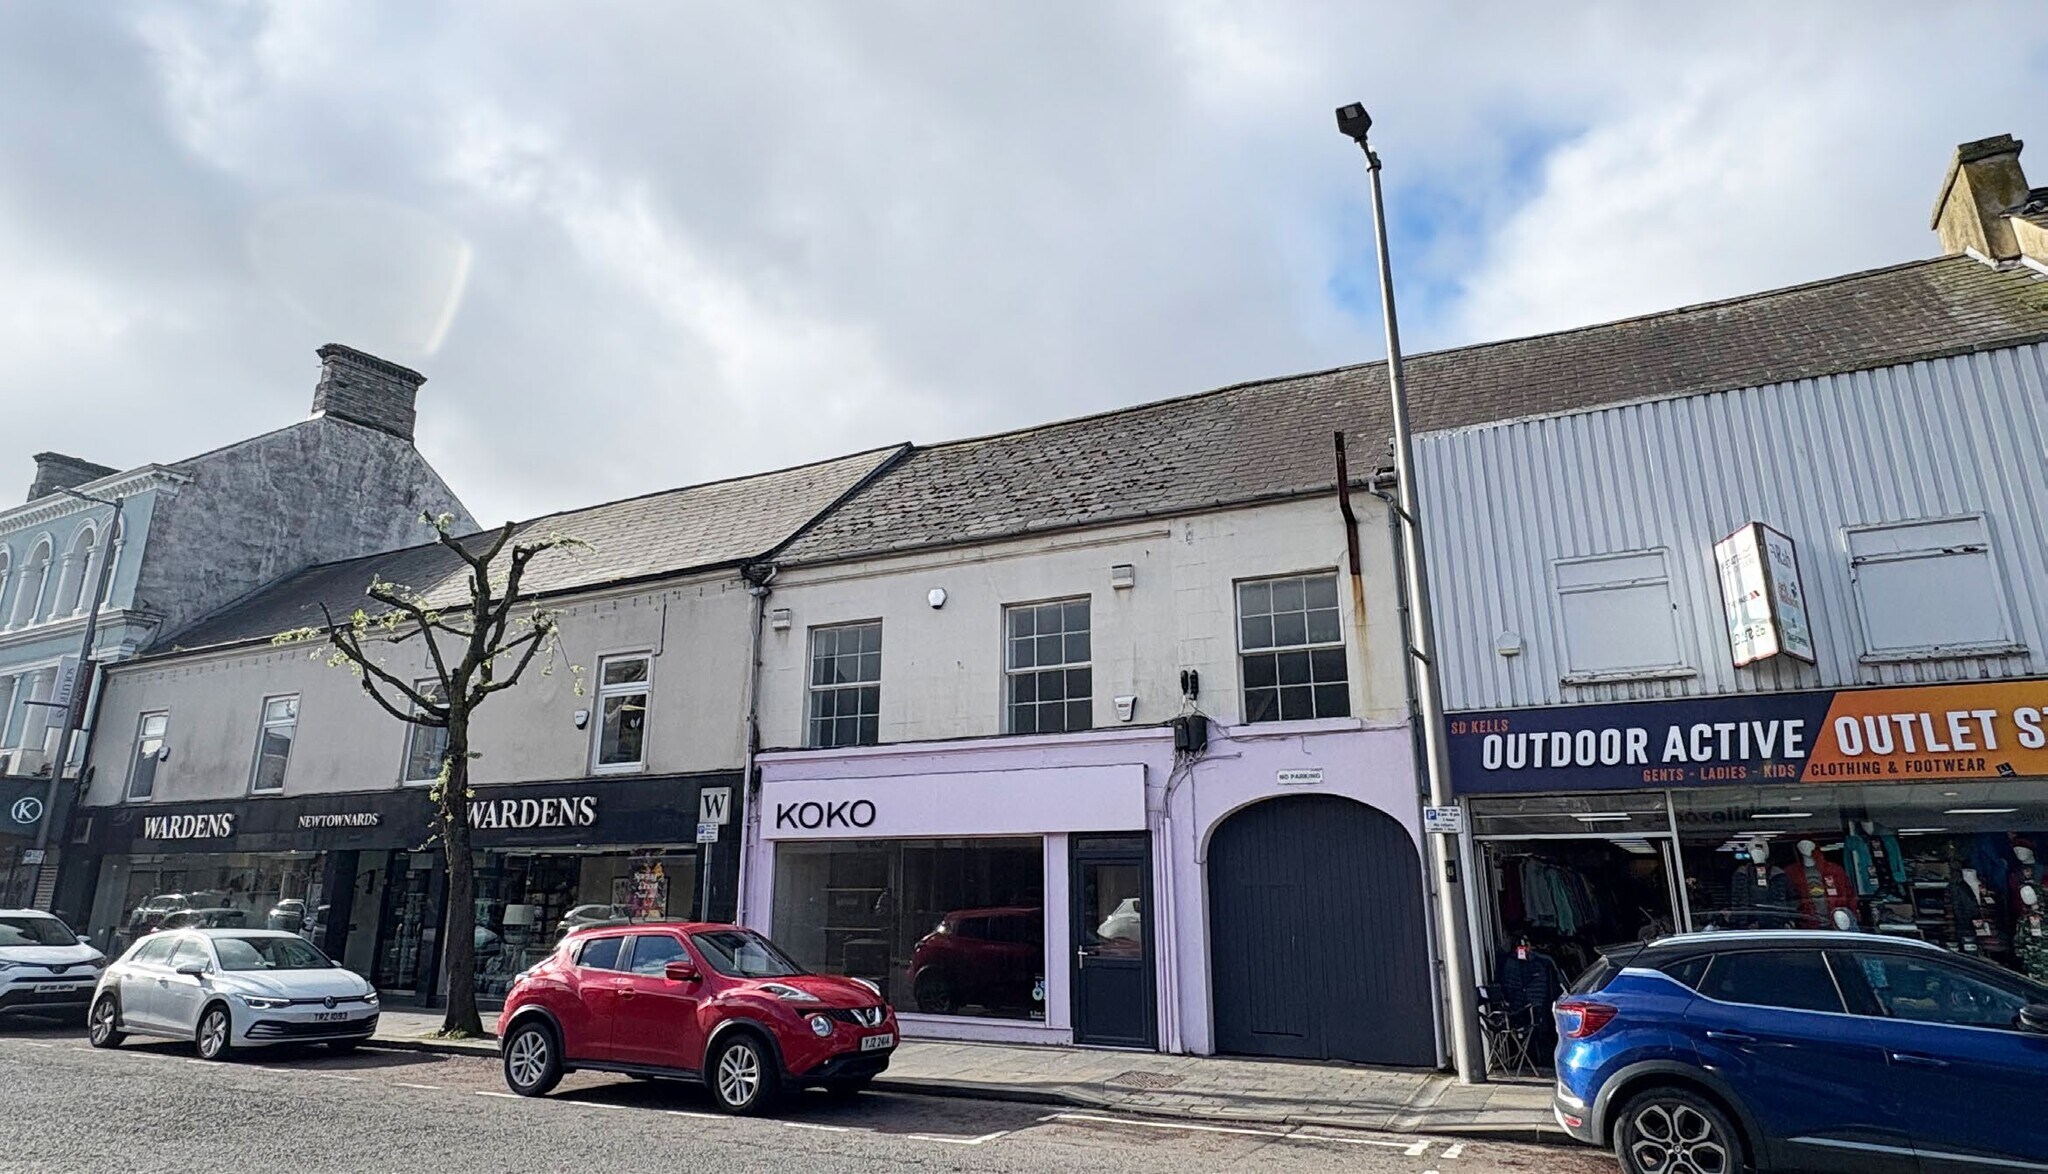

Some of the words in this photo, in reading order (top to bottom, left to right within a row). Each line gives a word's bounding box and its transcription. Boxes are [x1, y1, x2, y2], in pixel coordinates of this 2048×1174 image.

[1451, 721, 1466, 734] SD
[1471, 719, 1509, 733] KELLS
[1834, 710, 1998, 756] OUTLET
[2013, 706, 2048, 749] S
[1482, 727, 1648, 770] OUTDOOR
[1661, 719, 1805, 763] ACTIVE
[1643, 768, 1684, 782] GENTS
[1700, 766, 1747, 780] LADIES
[1763, 764, 1796, 778] KIDS
[1811, 761, 1881, 776] CLOTHING
[1888, 761, 1898, 773] &
[1905, 758, 1986, 773] FOOTWEAR
[466, 796, 597, 829] WARDENS
[703, 794, 727, 819] W
[776, 799, 876, 829] KOKO
[143, 812, 235, 840] WARDENS
[298, 813, 380, 829] NEWTOWNARDS
